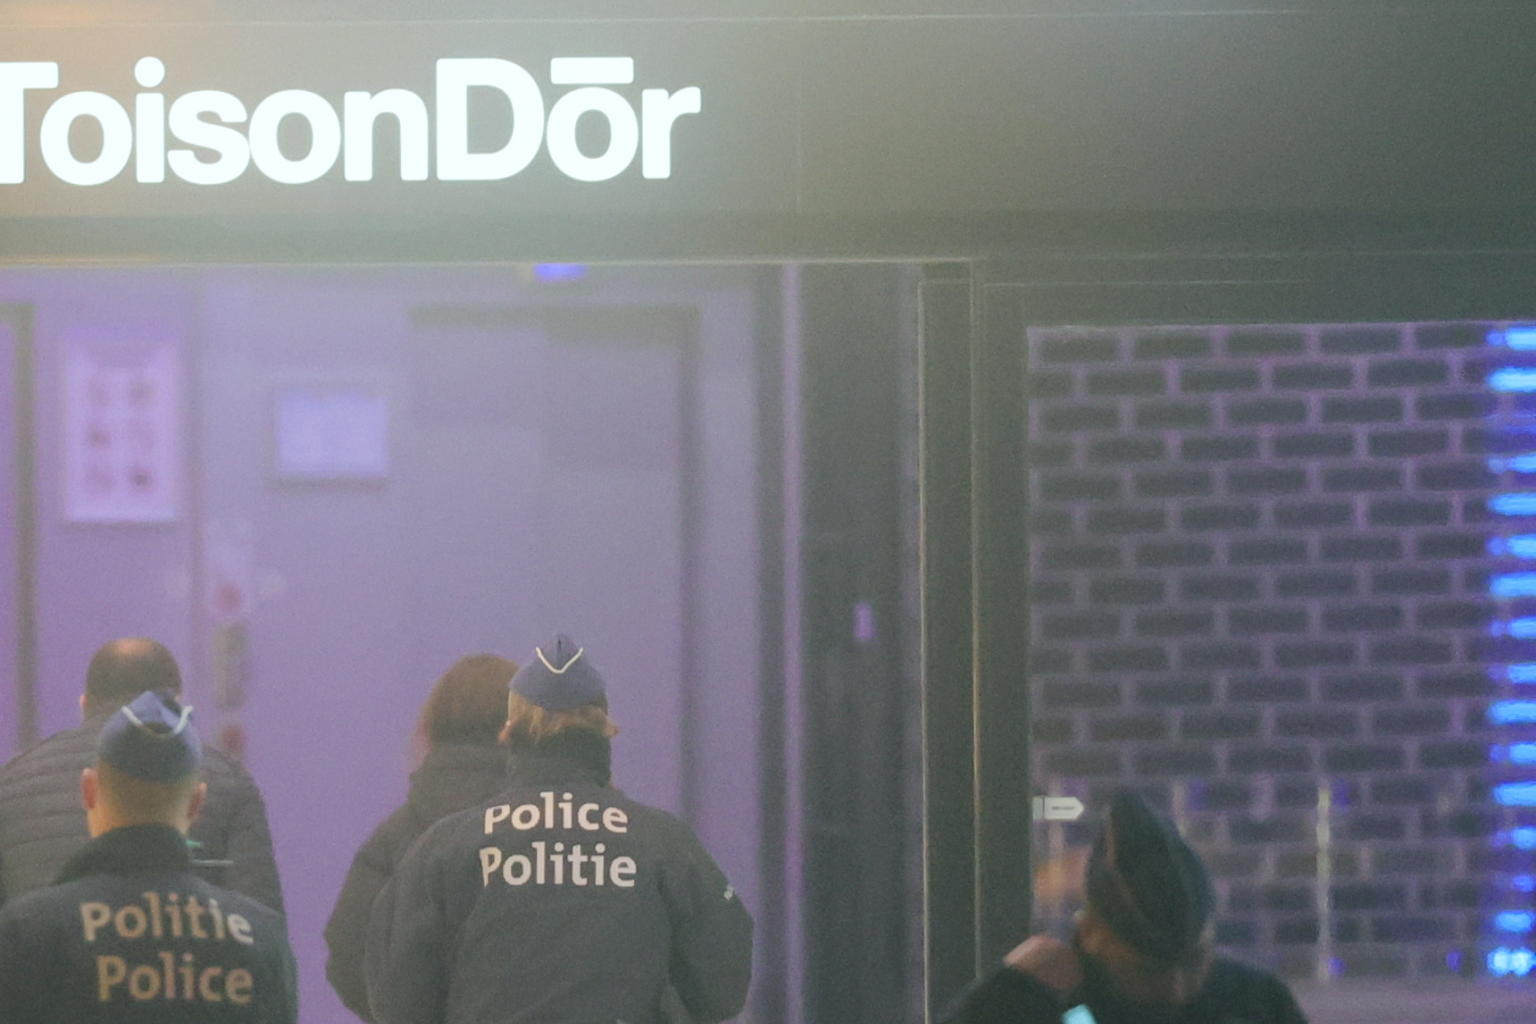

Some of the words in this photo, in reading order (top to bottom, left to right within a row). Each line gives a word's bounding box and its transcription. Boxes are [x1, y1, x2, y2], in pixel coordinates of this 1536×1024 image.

[484, 791, 628, 834] Police
[479, 841, 637, 888] Politie
[81, 893, 254, 944] Politie
[97, 952, 253, 1002] Police
